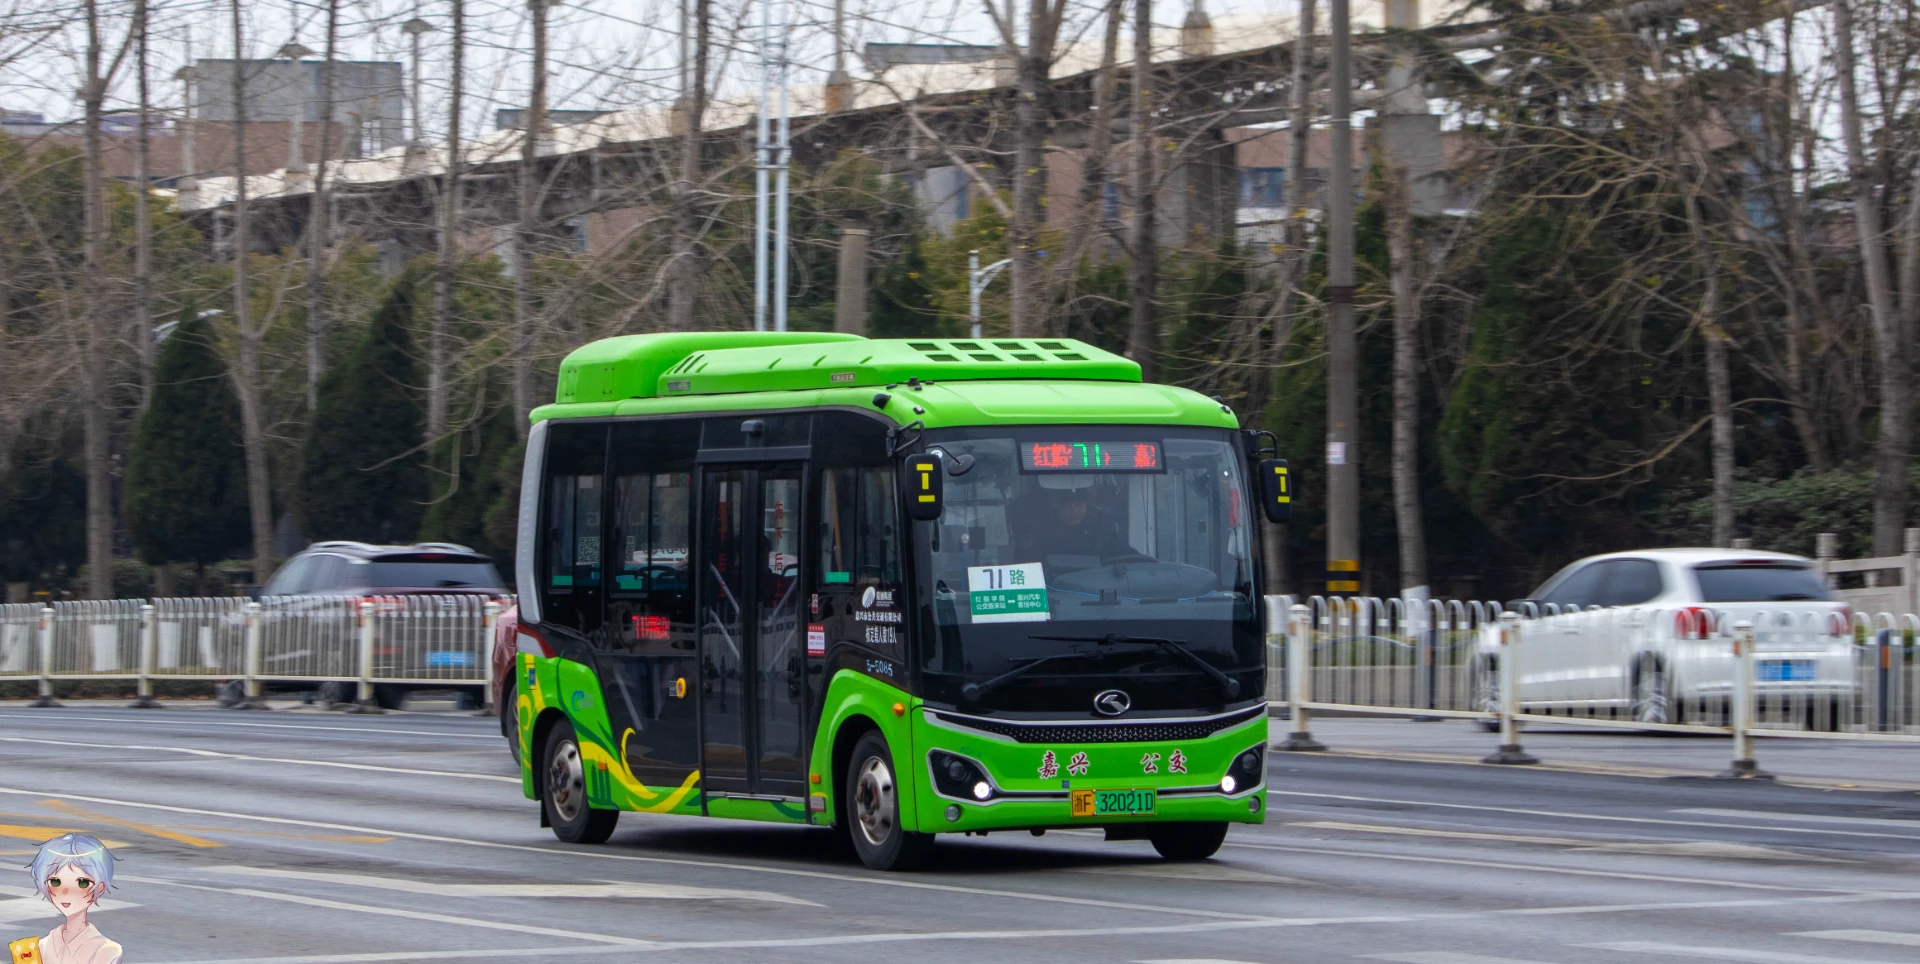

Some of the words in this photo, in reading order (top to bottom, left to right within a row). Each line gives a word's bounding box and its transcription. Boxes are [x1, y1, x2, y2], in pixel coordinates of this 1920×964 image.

[1073, 443, 1101, 467] 71
[866, 659, 893, 677] 5-5085
[1038, 750, 1091, 779] 嘉兴
[1140, 749, 1188, 773] 公交
